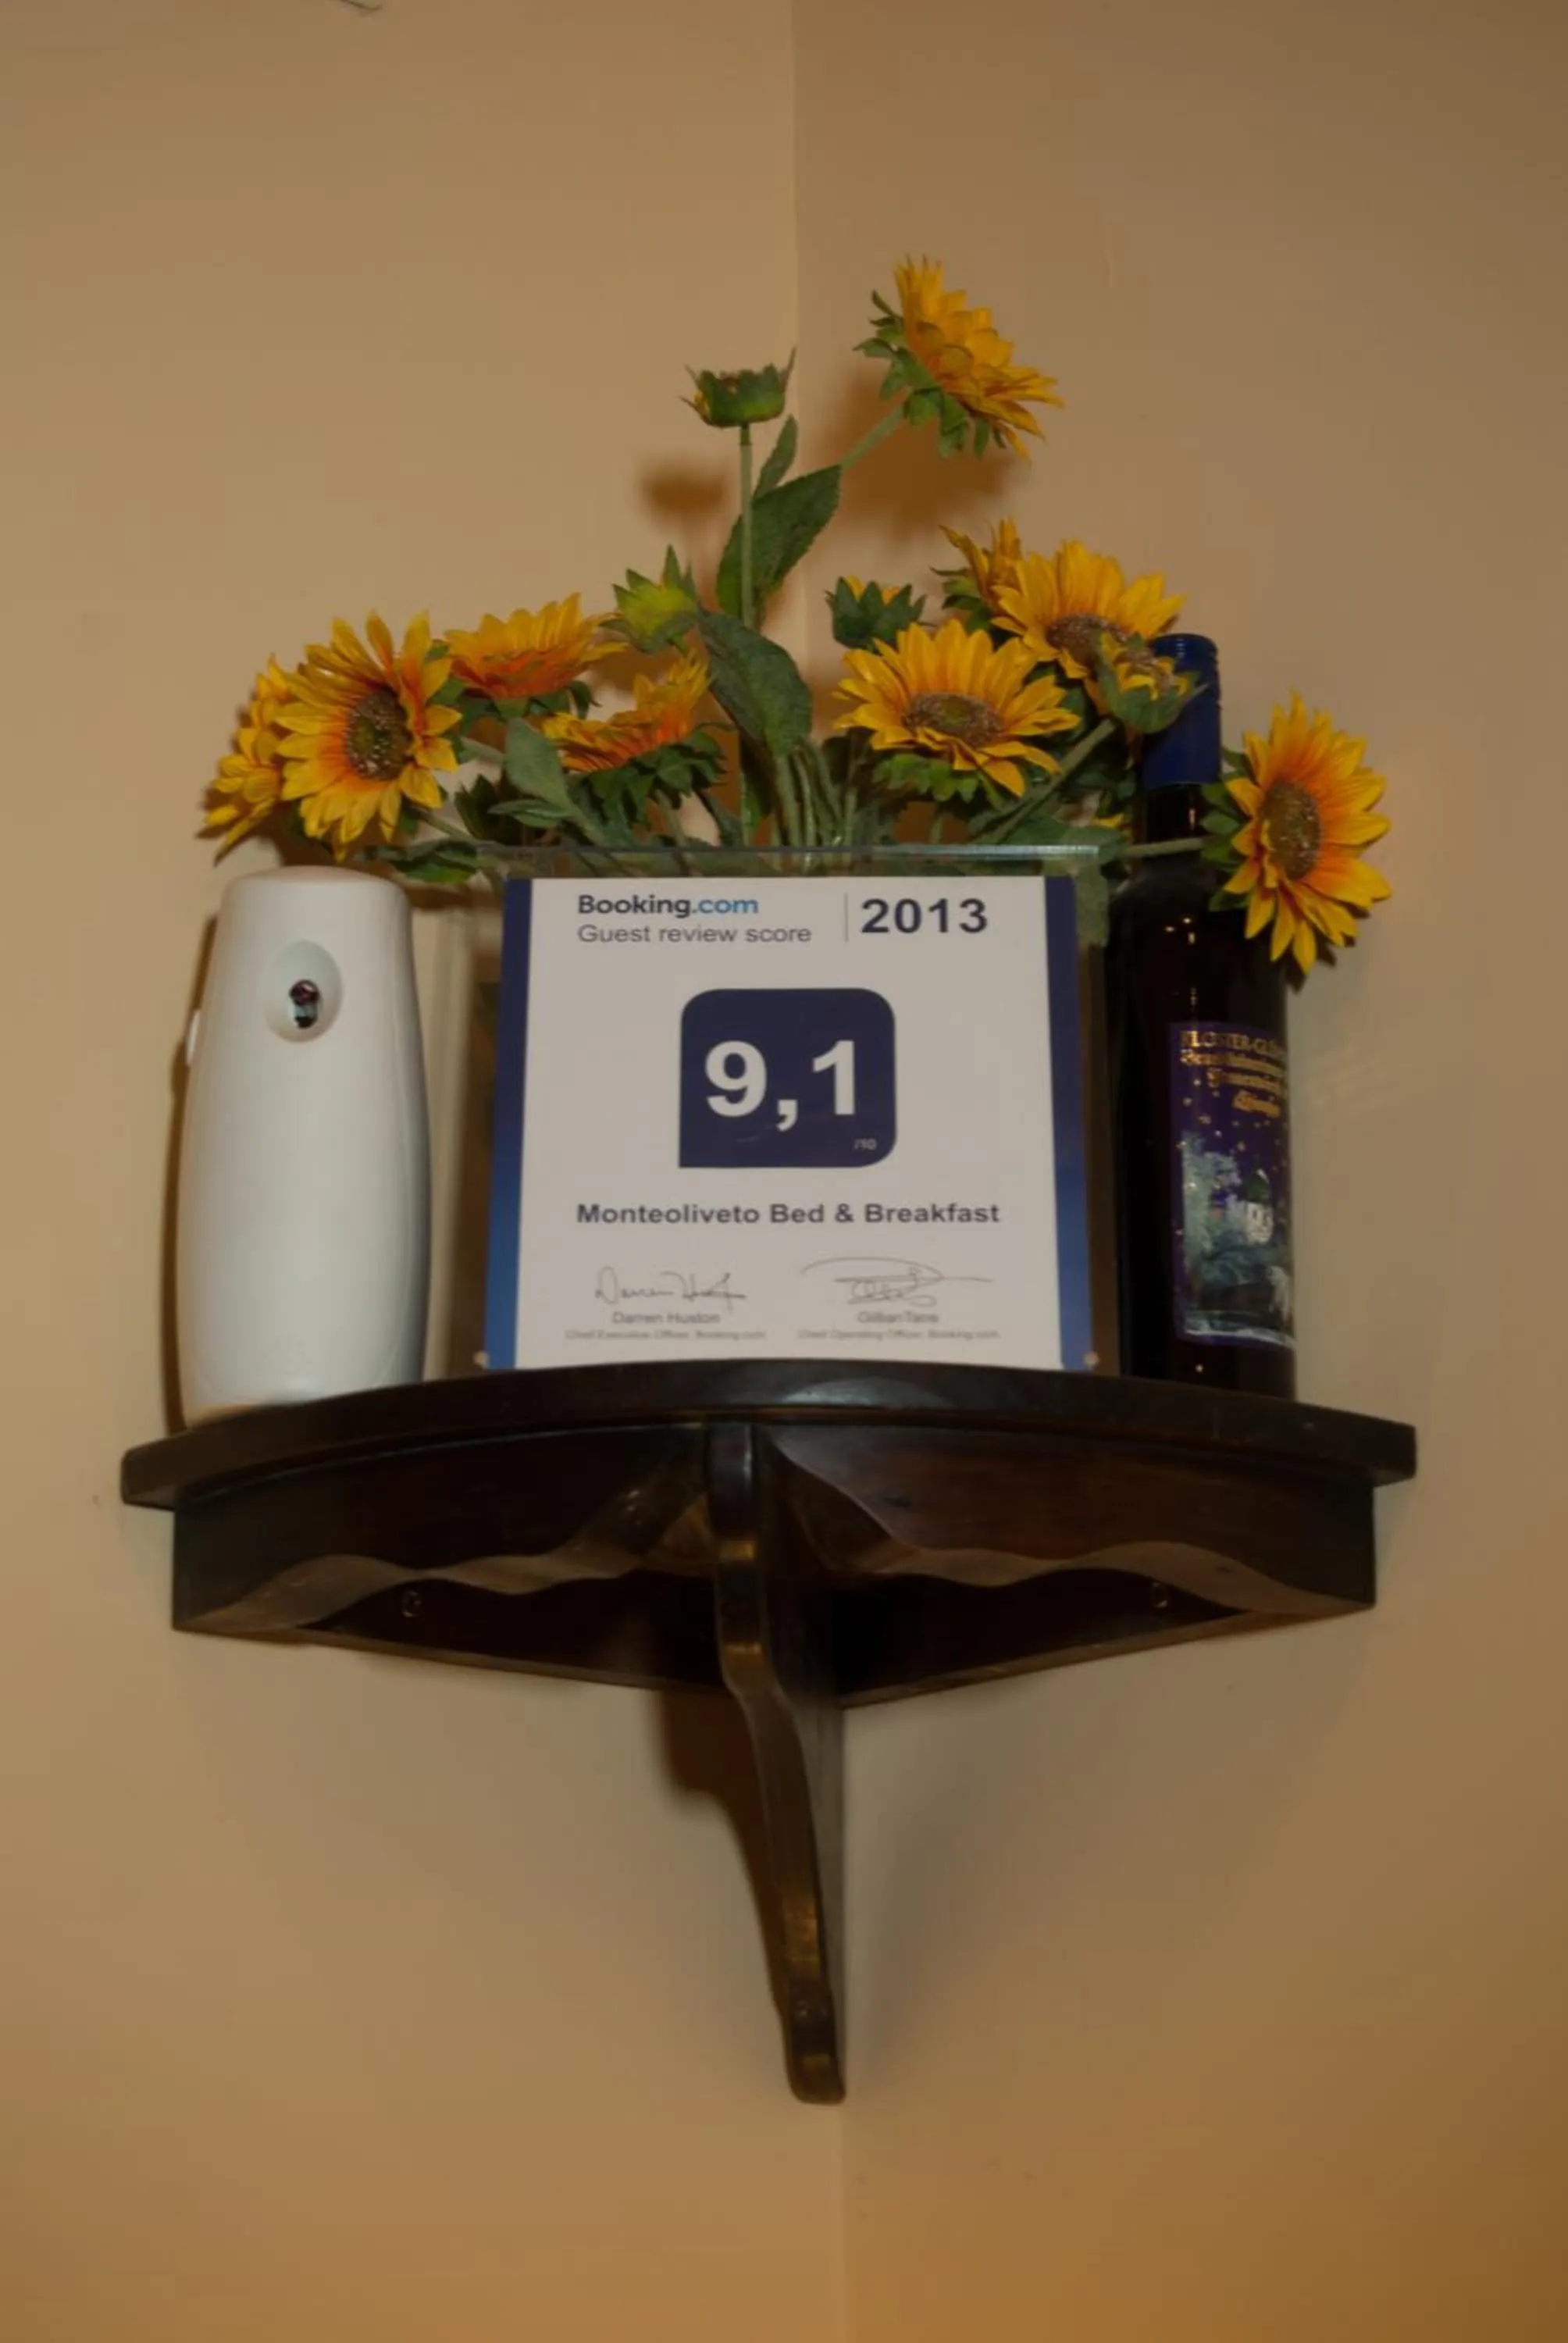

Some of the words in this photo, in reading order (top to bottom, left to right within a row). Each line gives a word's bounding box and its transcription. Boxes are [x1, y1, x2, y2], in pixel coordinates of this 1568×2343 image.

[577, 894, 759, 919] Booking.com
[861, 897, 989, 935] 2013
[577, 924, 651, 943] Guest
[658, 924, 738, 943] review
[745, 928, 812, 943] score
[704, 1040, 856, 1132] 9,1
[576, 1203, 761, 1225] Monteoliveto
[770, 1203, 825, 1225] Bed
[833, 1202, 855, 1224] &
[864, 1202, 1000, 1224] Breakfast
[611, 1311, 664, 1325] Darren
